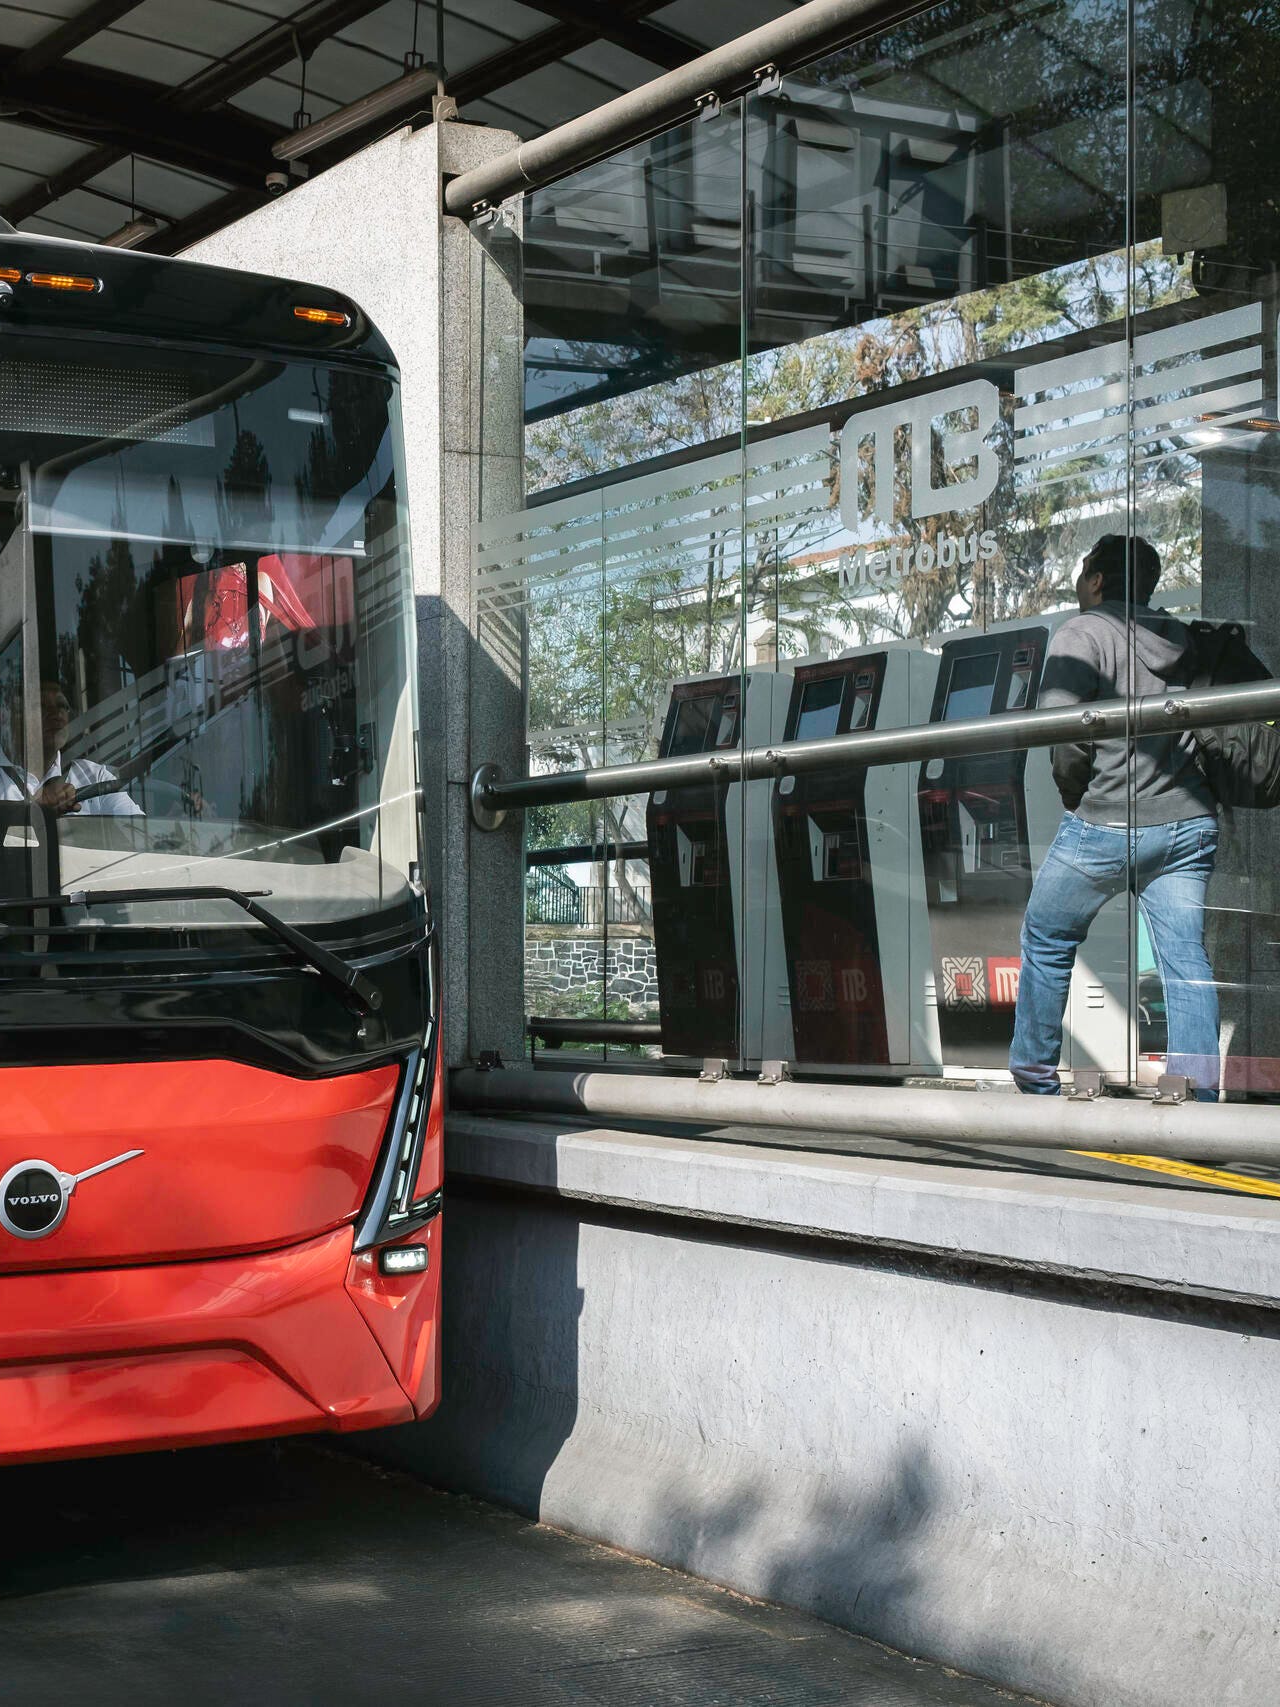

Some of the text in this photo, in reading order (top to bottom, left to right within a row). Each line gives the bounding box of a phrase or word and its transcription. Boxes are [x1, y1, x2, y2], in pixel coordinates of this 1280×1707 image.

[840, 378, 999, 532] MB
[838, 522, 998, 588] Metrobús
[841, 968, 868, 1002] MB
[8, 1193, 59, 1206] VOLVO
